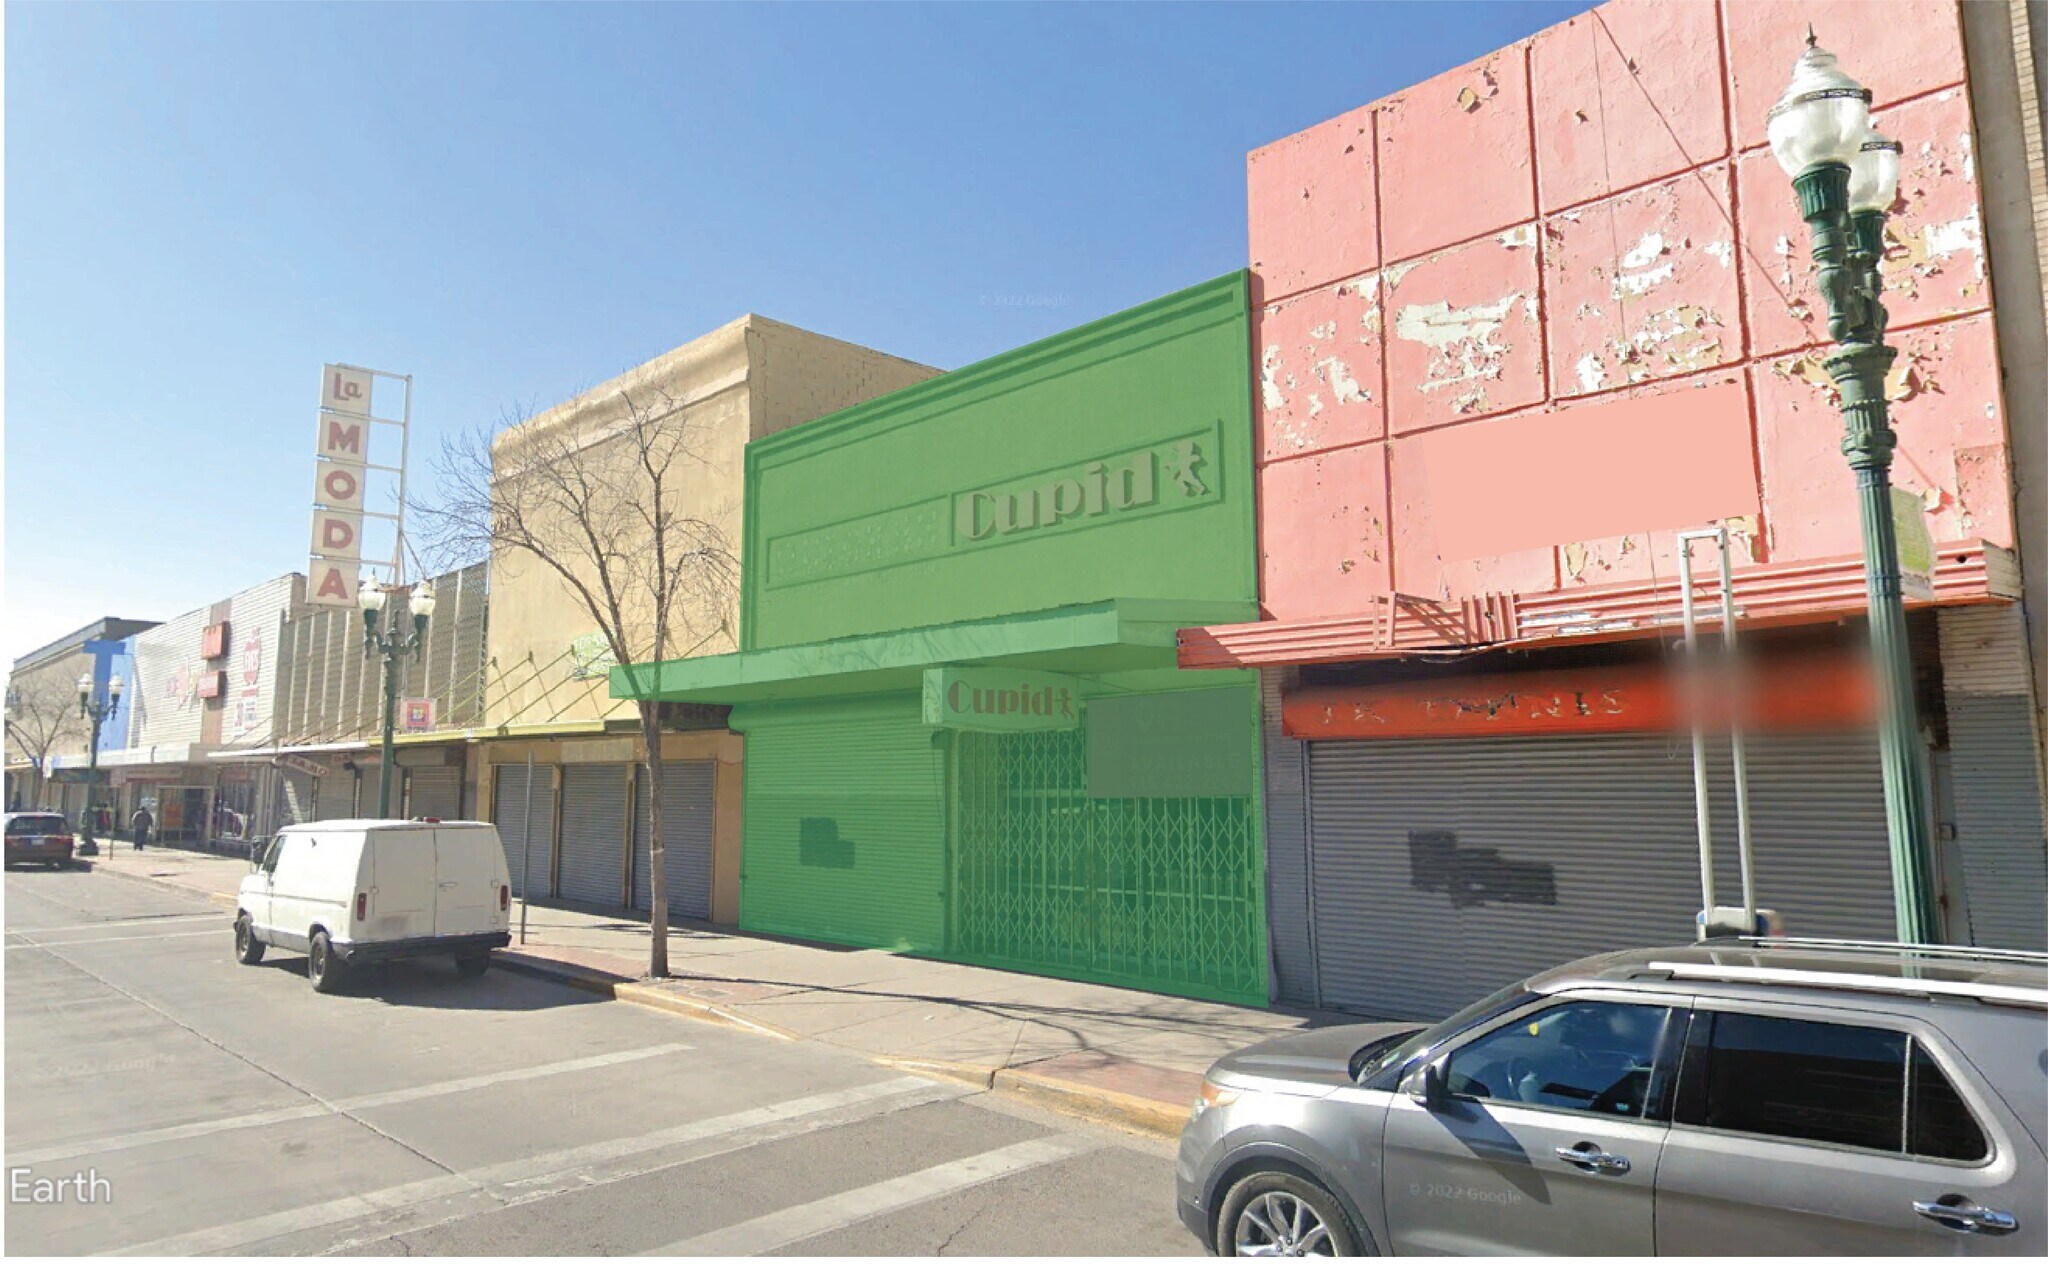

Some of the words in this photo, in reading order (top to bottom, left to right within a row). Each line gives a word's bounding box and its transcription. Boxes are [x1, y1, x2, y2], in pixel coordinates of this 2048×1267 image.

[332, 371, 362, 402] La
[317, 420, 361, 599] MODA
[956, 450, 1156, 540] Cupid
[947, 679, 1054, 716] Cupid
